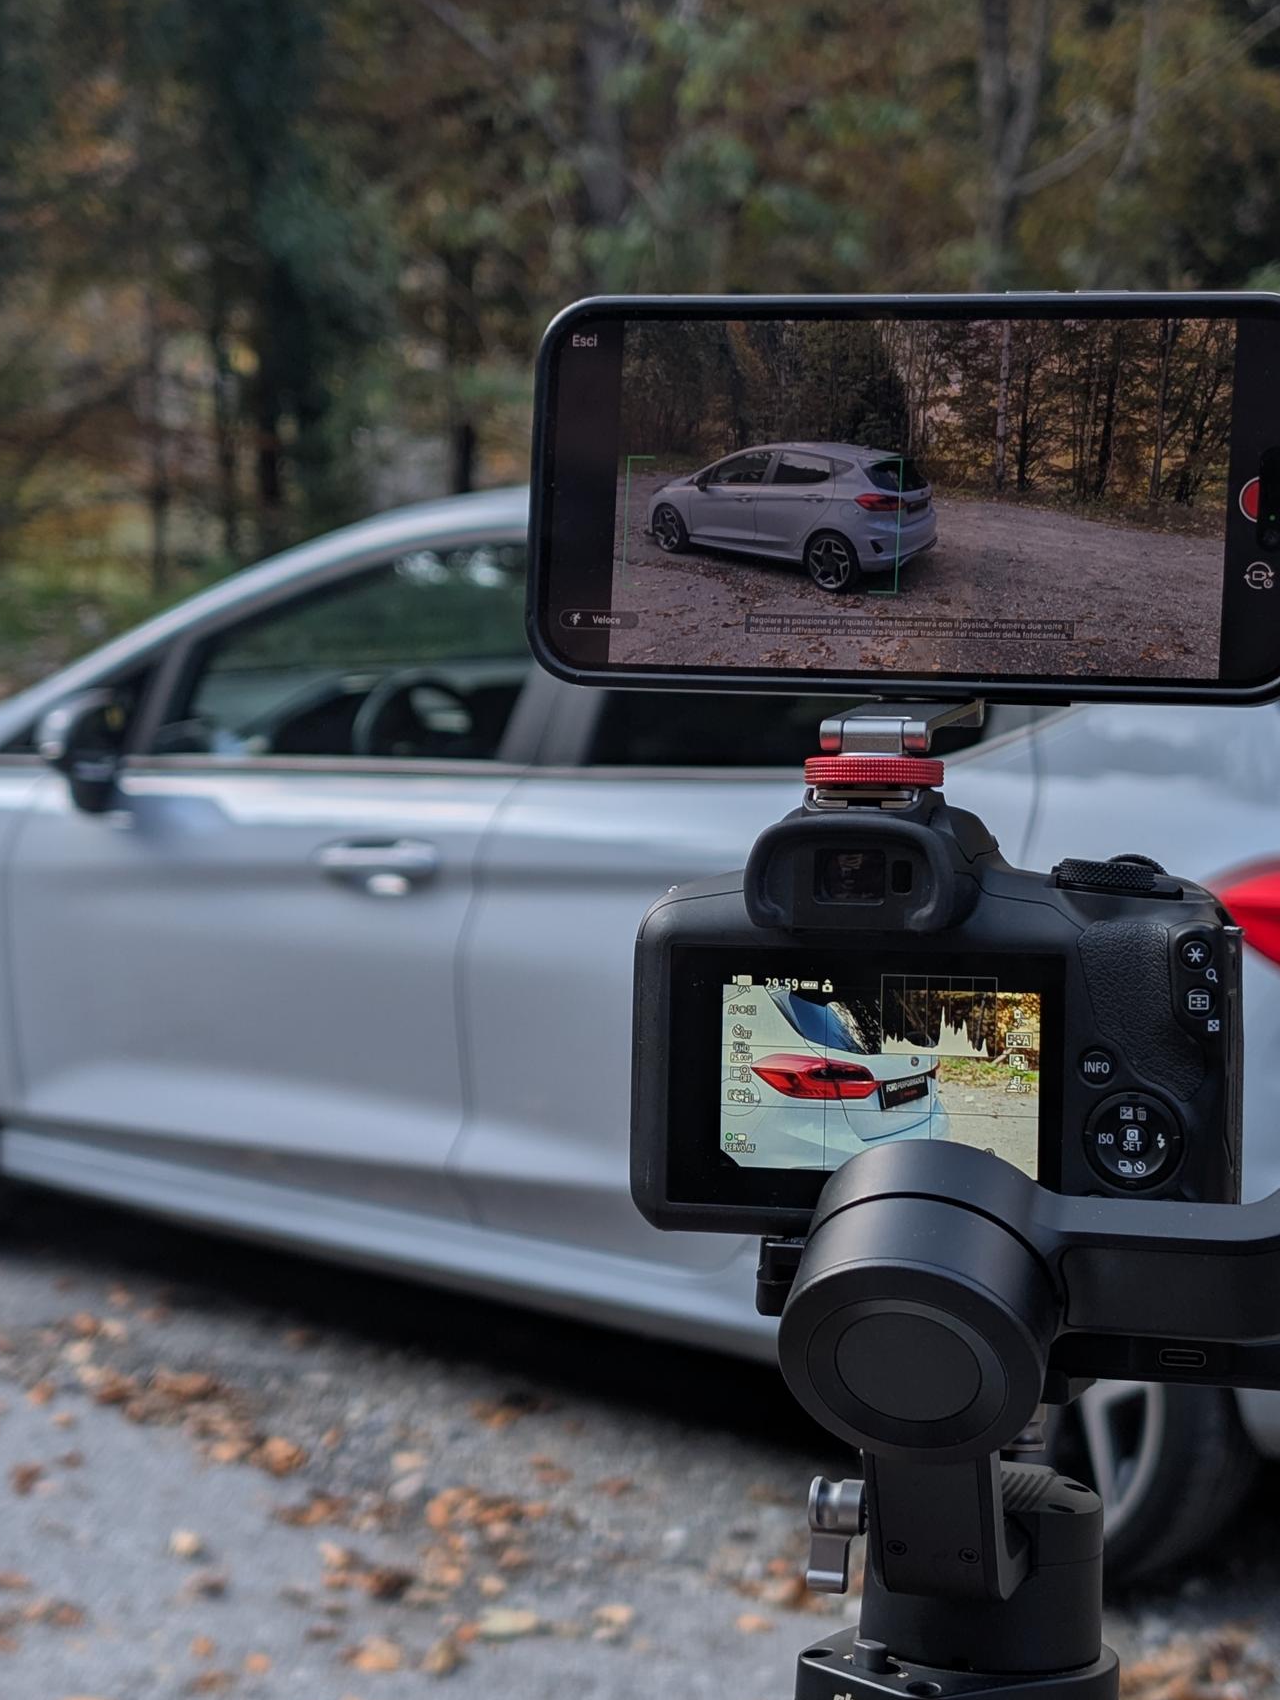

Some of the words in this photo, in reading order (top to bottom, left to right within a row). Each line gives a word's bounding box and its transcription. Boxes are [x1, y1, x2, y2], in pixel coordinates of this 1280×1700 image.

[572, 333, 598, 347] Esci
[592, 614, 621, 625] Veloce
[750, 616, 782, 625] Regolare
[783, 616, 790, 624] la
[792, 617, 826, 625] posizione
[842, 619, 873, 627] riquadro
[875, 619, 893, 627] della
[895, 619, 937, 627] fotocamera
[993, 621, 1026, 630] Premere
[1027, 622, 1042, 630] due
[1043, 622, 1063, 630] volte
[749, 626, 781, 634] pulsante
[833, 628, 845, 636] per
[920, 629, 954, 637] tracciato
[969, 630, 1001, 639] riquadro
[1002, 630, 1021, 638] della
[765, 977, 799, 991] 29:59
[1083, 1060, 1110, 1075] INFO
[1018, 1084, 1031, 1094] OFF
[1097, 1132, 1115, 1145] ISO
[1122, 1140, 1143, 1152] SET
